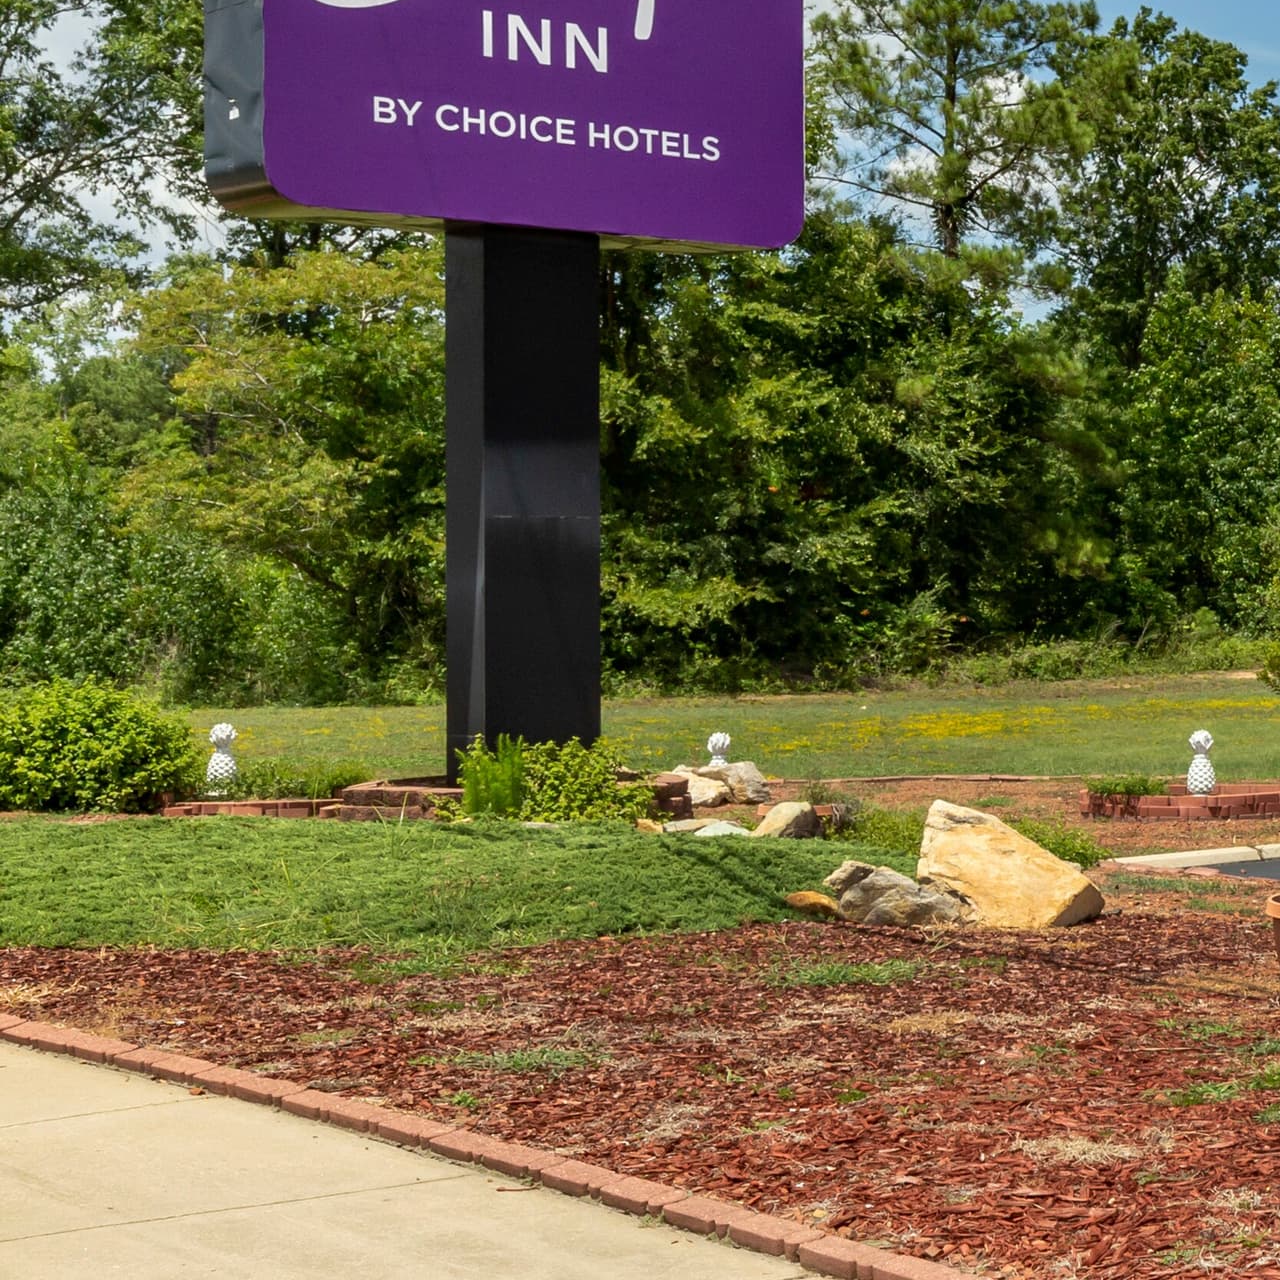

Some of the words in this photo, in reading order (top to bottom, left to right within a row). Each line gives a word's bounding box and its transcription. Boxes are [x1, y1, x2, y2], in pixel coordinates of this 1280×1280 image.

[482, 9, 609, 74] INN
[373, 95, 423, 127] BY
[435, 103, 576, 146] CHOICE
[588, 121, 721, 162] HOTELS
